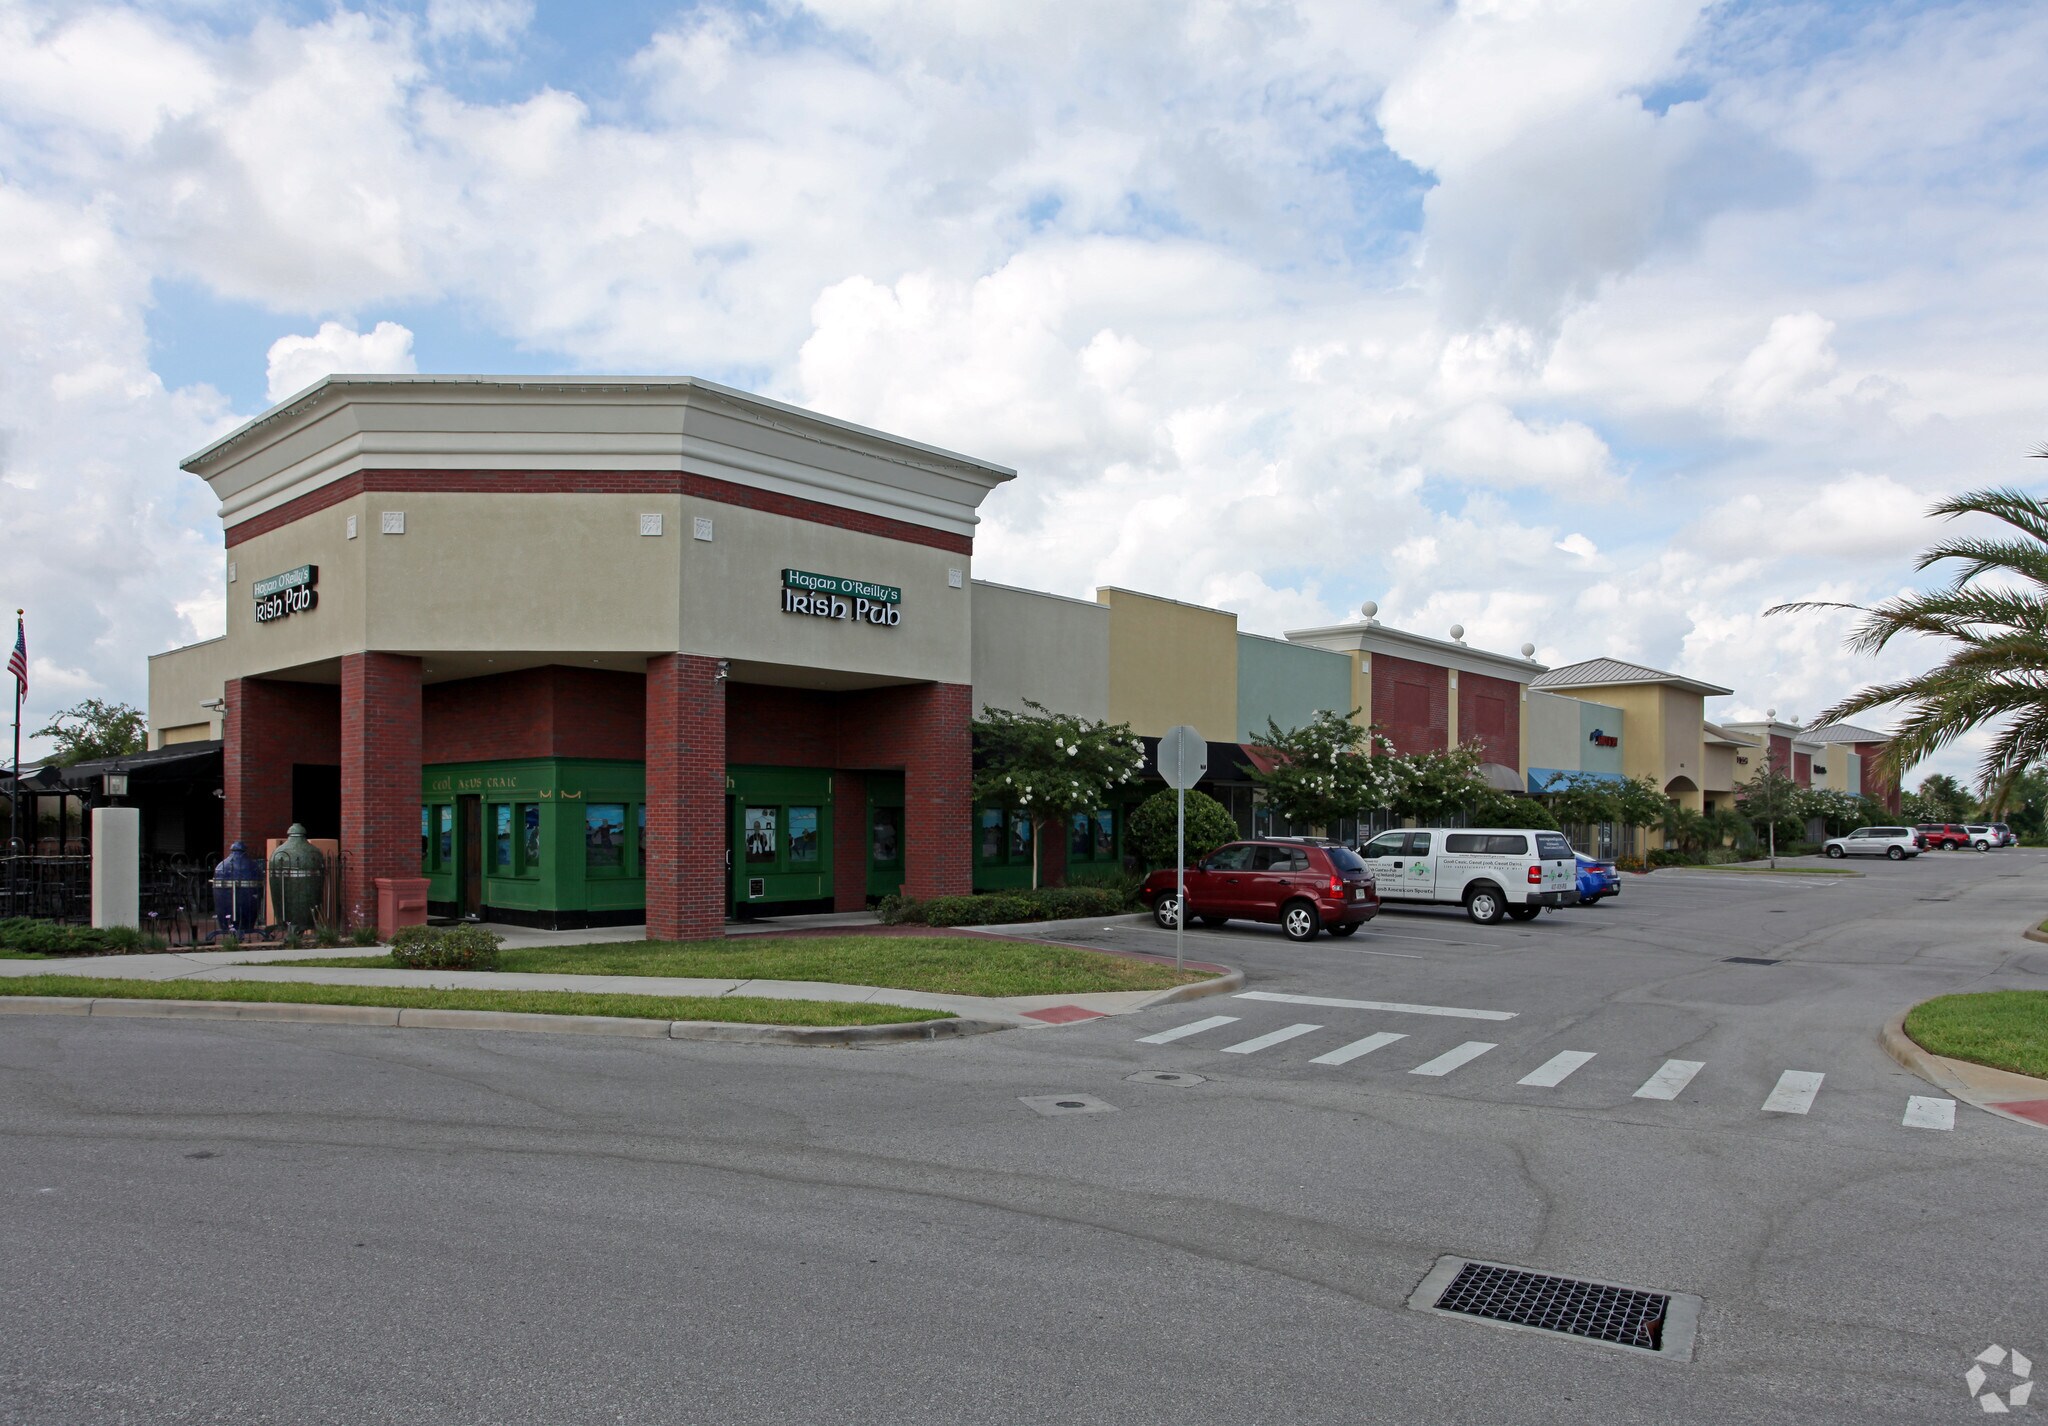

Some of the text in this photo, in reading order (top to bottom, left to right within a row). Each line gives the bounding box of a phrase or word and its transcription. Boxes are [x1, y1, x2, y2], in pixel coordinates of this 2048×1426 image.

[254, 580, 277, 596] Hagan
[285, 584, 310, 614] Pub
[789, 570, 898, 601] Hagan O'Reilly's
[856, 597, 901, 626] Pub
